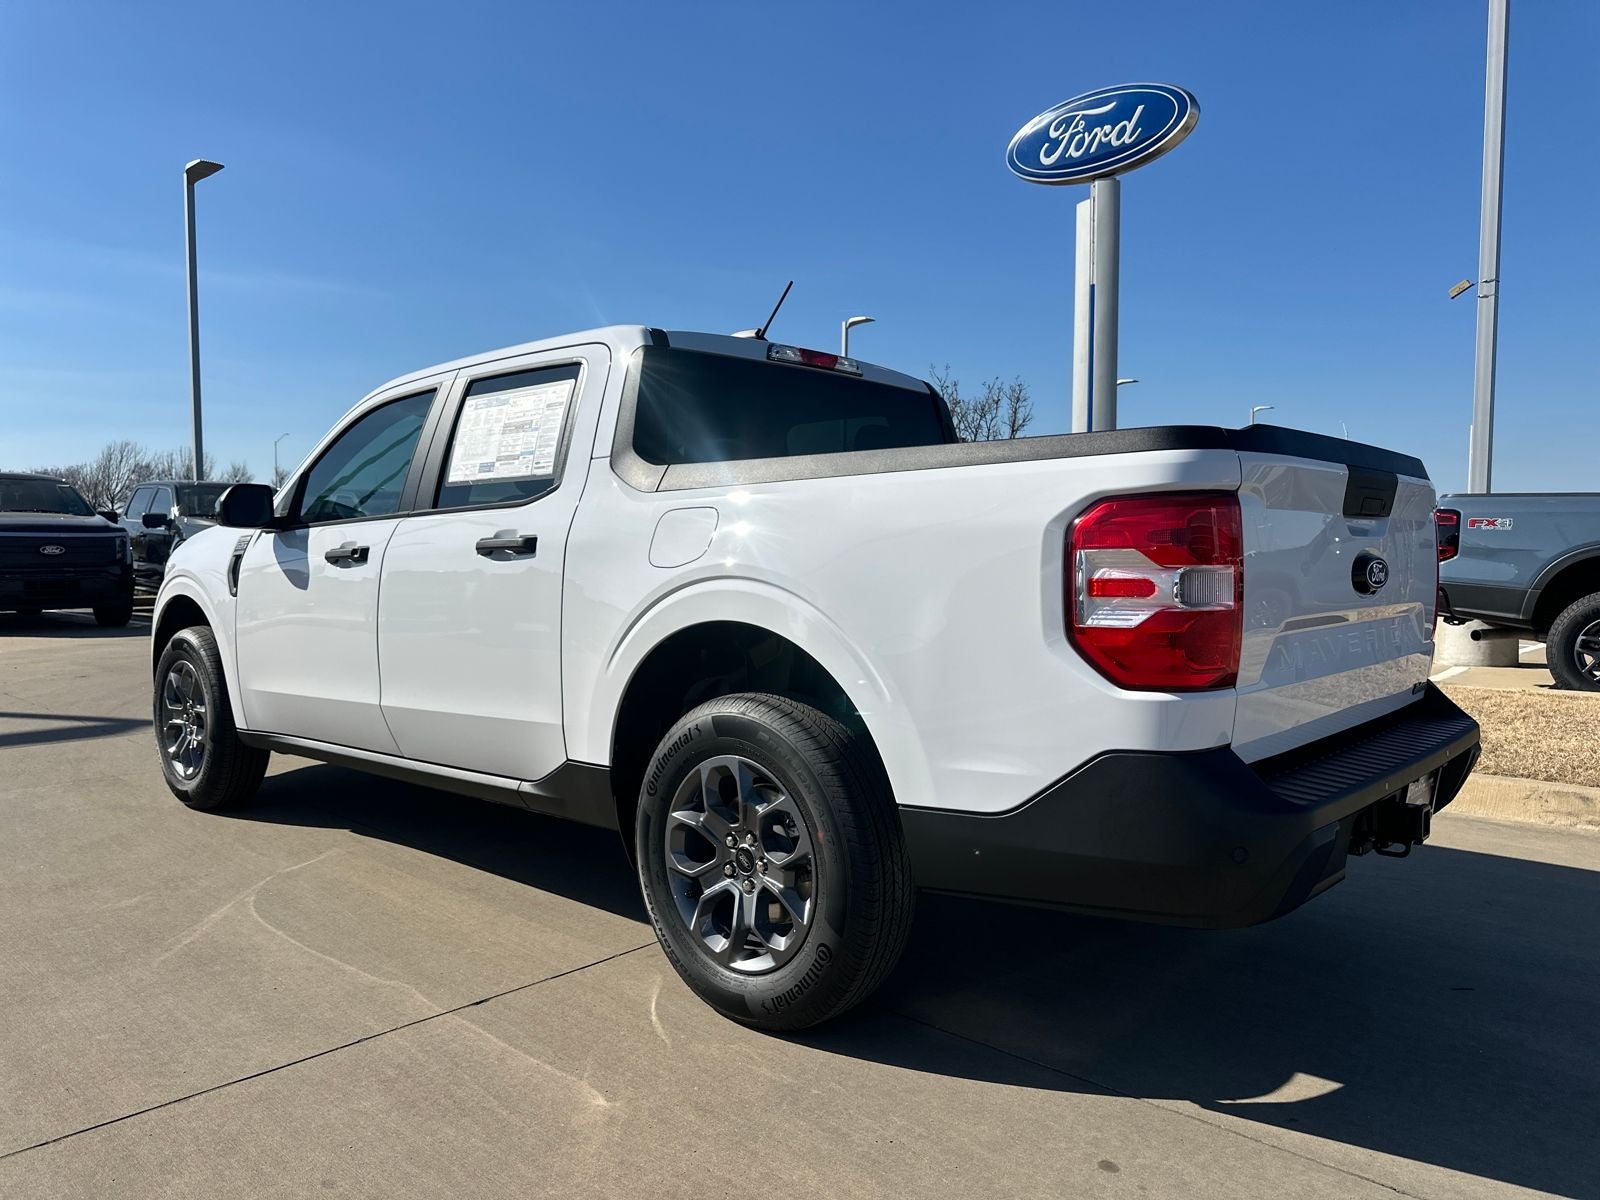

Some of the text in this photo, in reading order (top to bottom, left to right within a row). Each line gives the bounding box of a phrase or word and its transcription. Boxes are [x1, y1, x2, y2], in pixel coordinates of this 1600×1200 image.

[1039, 101, 1145, 166] Ford
[1467, 517, 1513, 529] FX4
[1371, 563, 1386, 582] Ford
[1276, 616, 1417, 673] MAVERICK
[646, 727, 694, 797] Continental
[771, 942, 833, 1013] Continental
